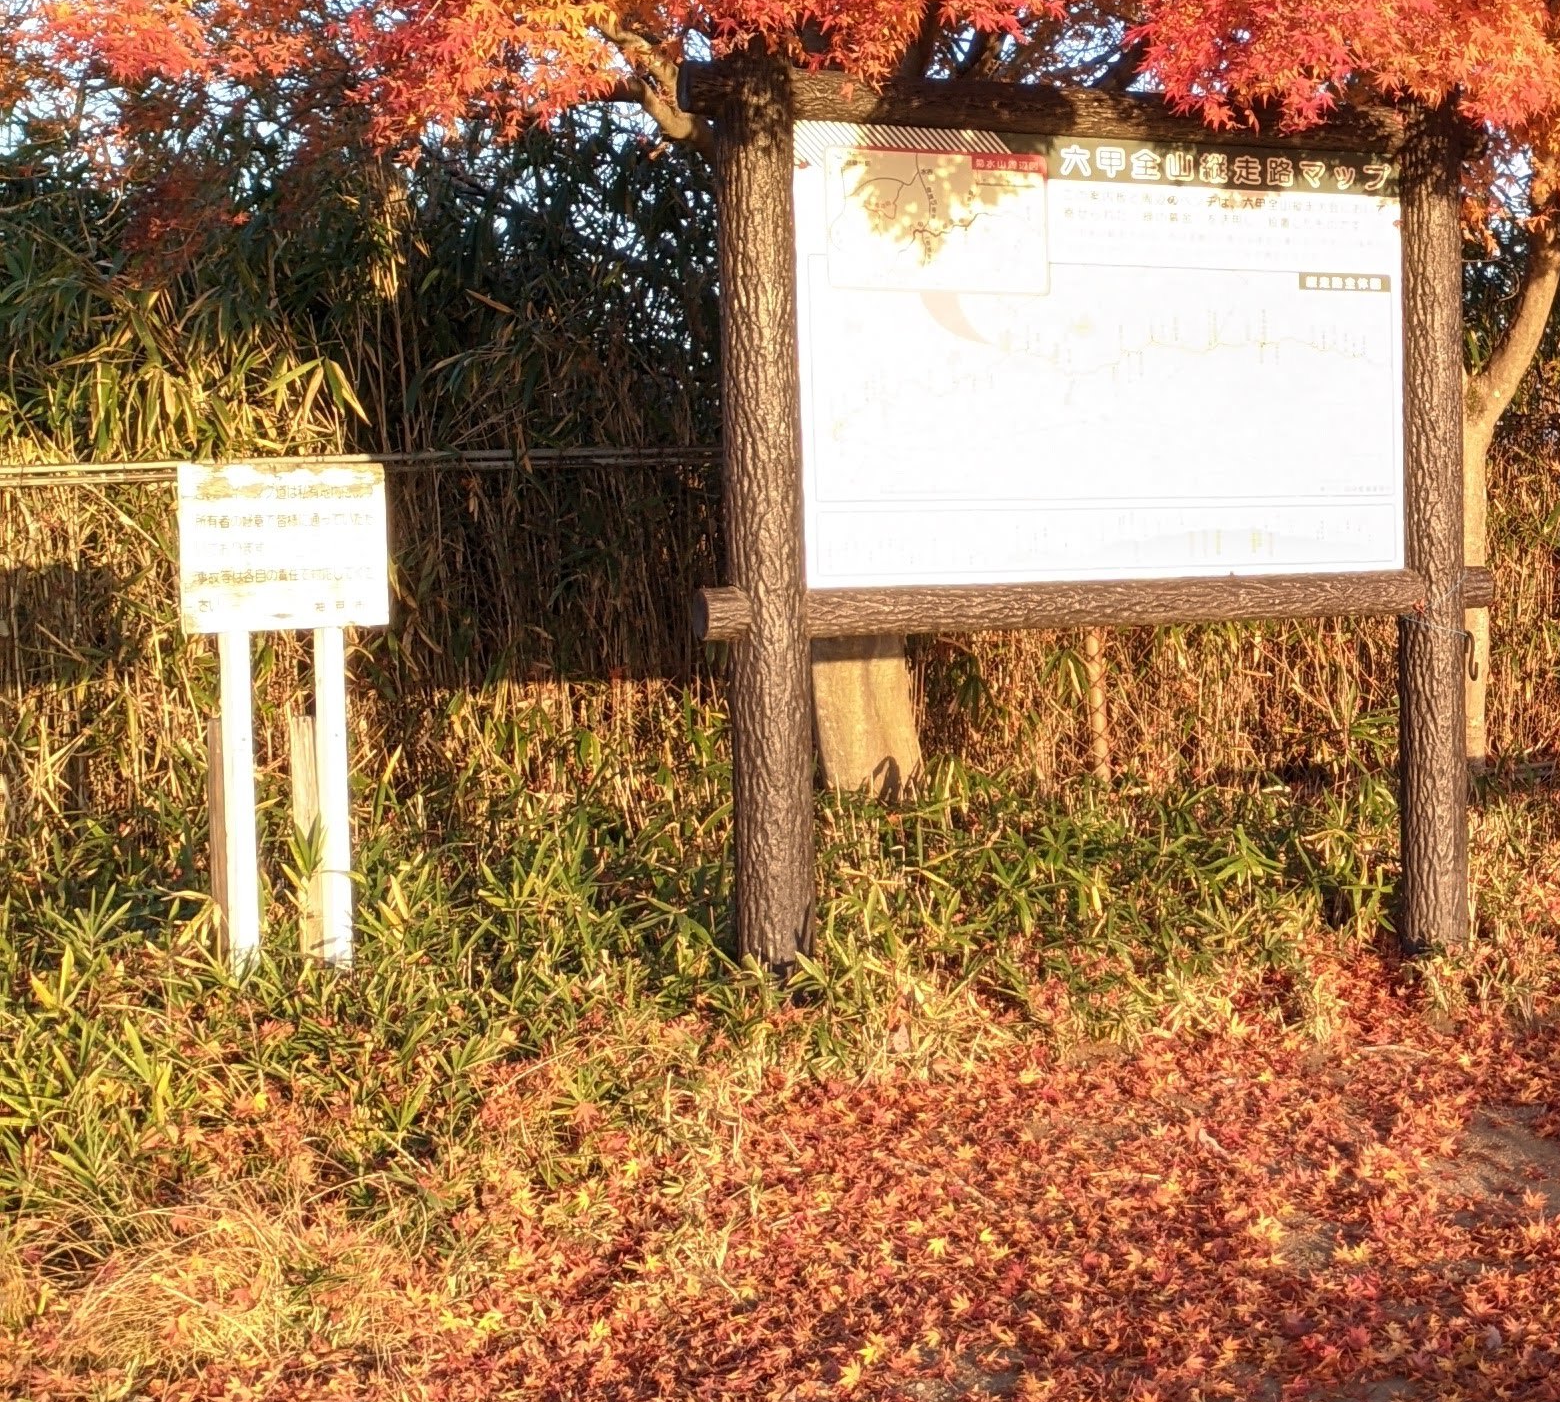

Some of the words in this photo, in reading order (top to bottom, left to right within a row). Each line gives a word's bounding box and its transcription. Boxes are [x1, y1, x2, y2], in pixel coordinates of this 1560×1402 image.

[1060, 145, 1391, 191] 六甲全山縦走路マップ
